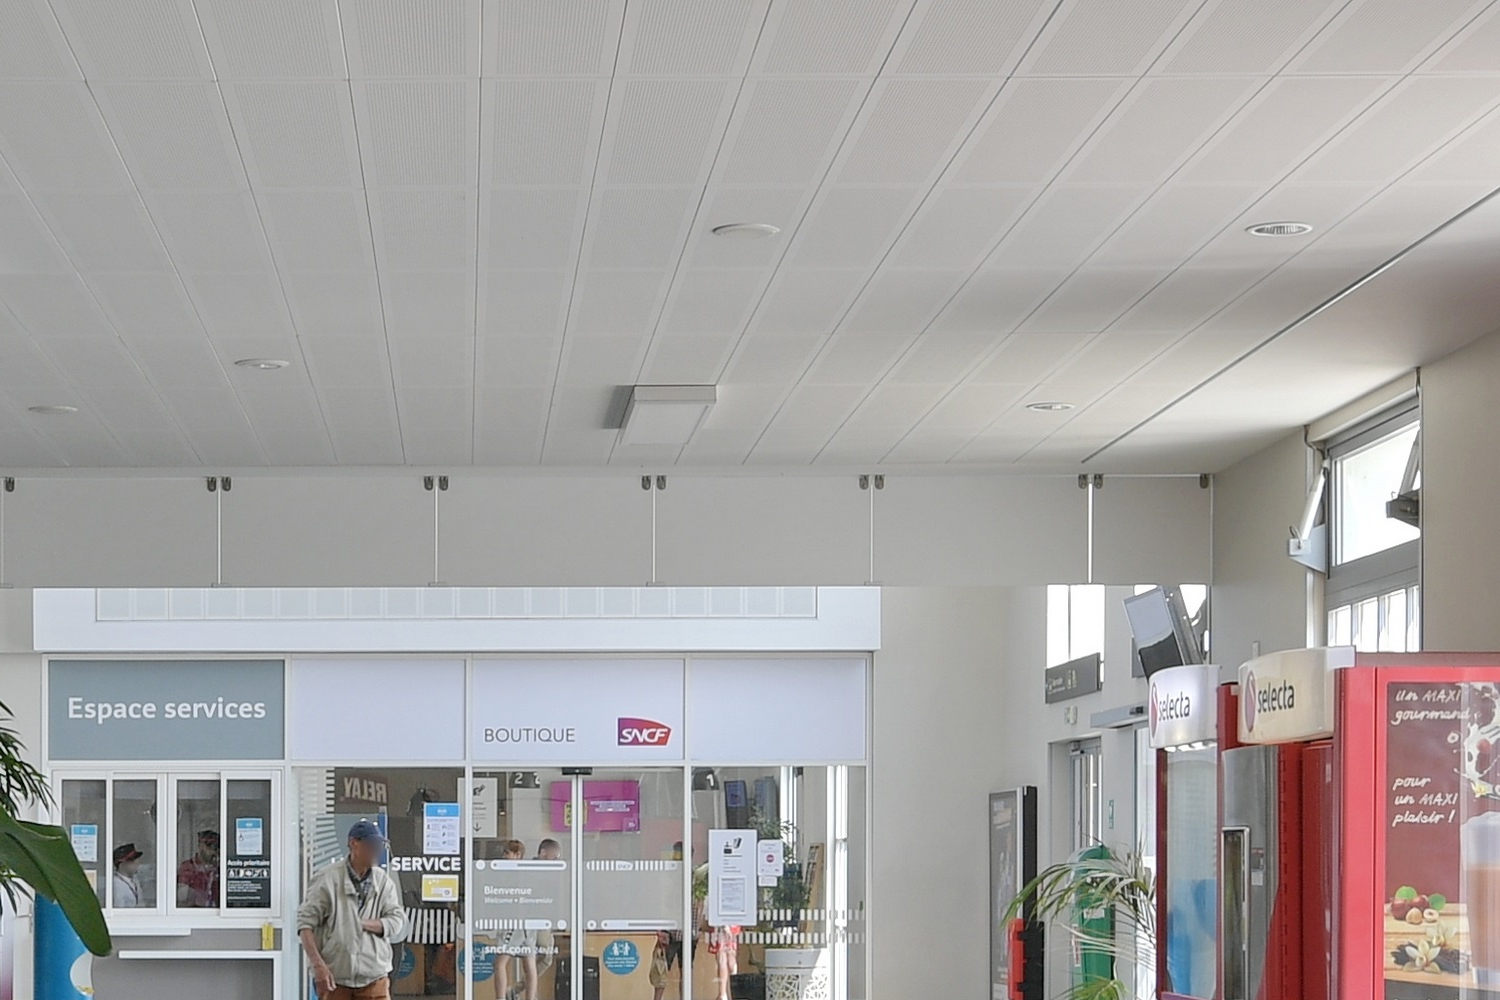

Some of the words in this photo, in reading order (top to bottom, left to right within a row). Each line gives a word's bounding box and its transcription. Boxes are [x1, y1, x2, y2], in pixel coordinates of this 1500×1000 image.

[1257, 679, 1295, 714] selecta
[1422, 688, 1462, 703] MAXI
[68, 697, 157, 725] Espace
[164, 697, 267, 719] services
[1158, 691, 1191, 721] selecta
[1391, 707, 1471, 726] gourmand
[484, 728, 575, 743] BOUTIQUE
[619, 728, 668, 743] SNCF
[514, 772, 523, 785] 2
[706, 773, 715, 787] 1
[1392, 776, 1431, 791] pour
[1394, 795, 1415, 806] un
[1419, 793, 1458, 807] MAXI
[1392, 810, 1444, 827] plaisir
[391, 856, 462, 872] SERVICE
[484, 885, 533, 895] Bienvenue
[484, 945, 531, 955] sncf.com
